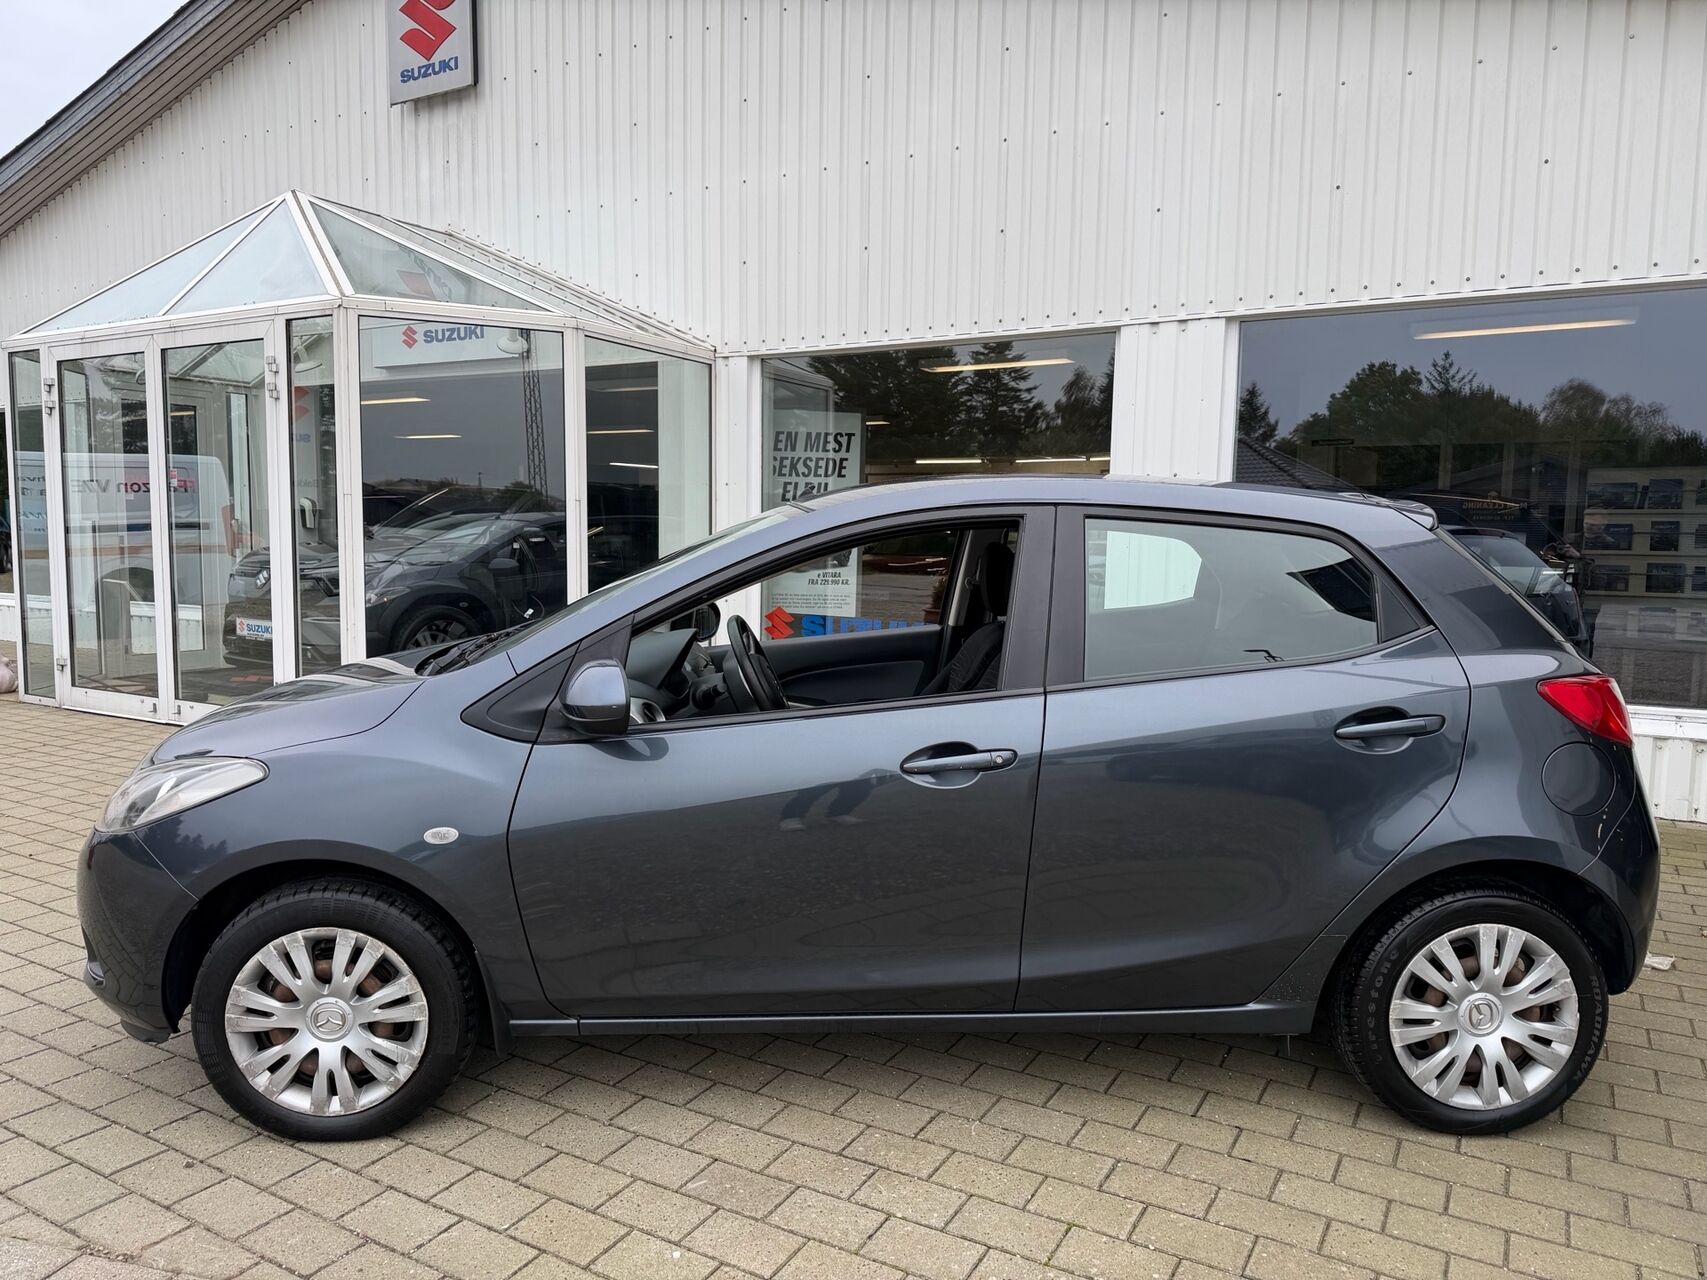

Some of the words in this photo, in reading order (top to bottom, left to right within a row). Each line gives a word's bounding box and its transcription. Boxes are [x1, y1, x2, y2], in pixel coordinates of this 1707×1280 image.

[400, 56, 458, 84] SUZUKI
[423, 326, 485, 344] SUZUKI
[804, 431, 856, 453] MEST
[1576, 975, 1603, 1081] ROADHAWK
